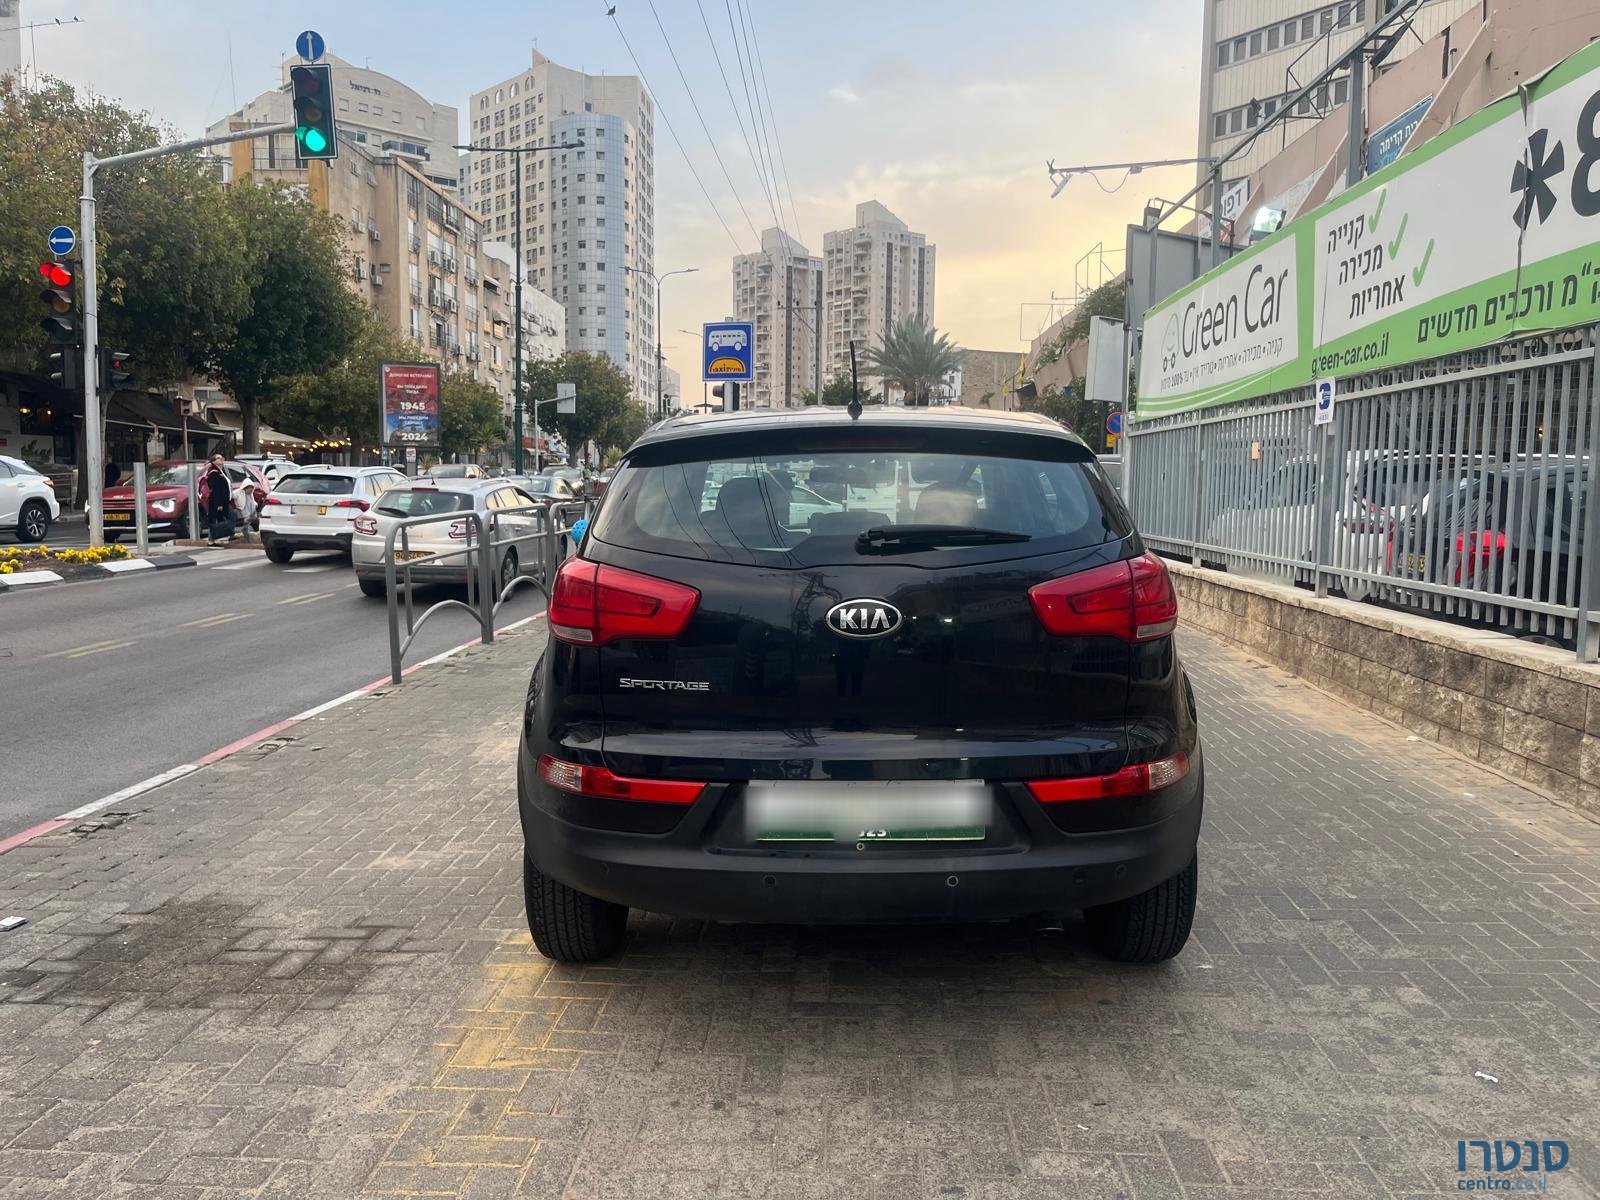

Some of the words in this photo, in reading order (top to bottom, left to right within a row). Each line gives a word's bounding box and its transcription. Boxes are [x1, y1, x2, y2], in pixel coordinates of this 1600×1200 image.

[1380, 130, 1403, 155] קדימה
[1221, 188, 1242, 216] דפו
[1327, 214, 1365, 255] קנייה
[1338, 244, 1383, 285] מכירה
[1182, 294, 1238, 358] Green
[1244, 264, 1288, 333] Car
[1349, 274, 1406, 319] אחריות
[1484, 280, 1554, 326] ורכבים
[1417, 303, 1478, 343] חדשים
[400, 401, 426, 411] 1945
[401, 432, 428, 441] 2024
[839, 608, 890, 629] KIA
[619, 677, 710, 691] SPORTAGE
